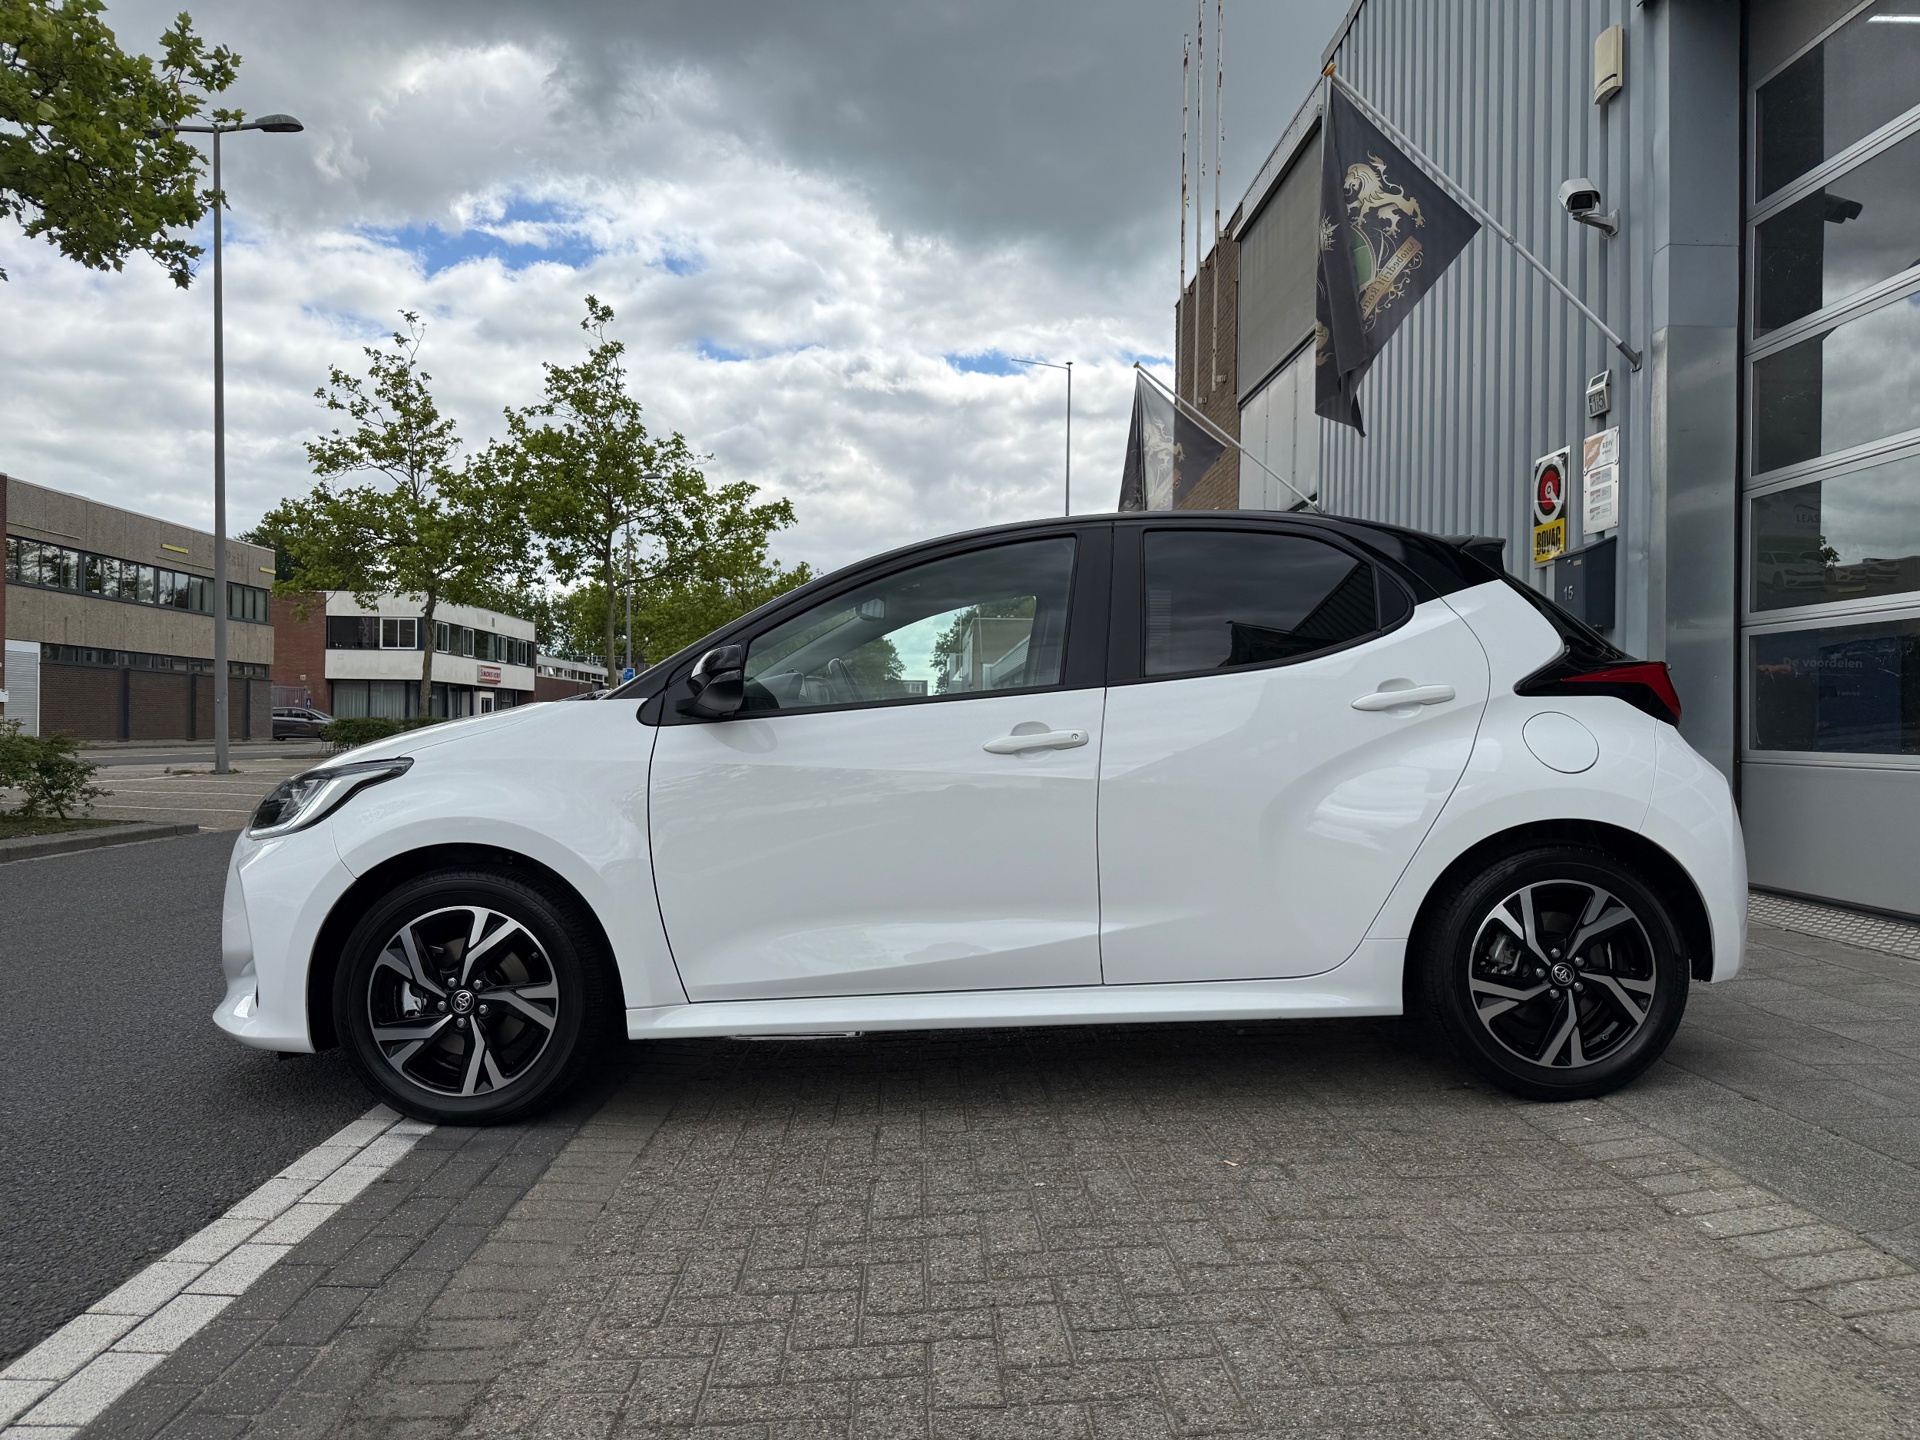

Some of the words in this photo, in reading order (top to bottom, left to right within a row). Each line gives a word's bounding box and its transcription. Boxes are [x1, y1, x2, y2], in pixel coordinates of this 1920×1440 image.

[1536, 526, 1561, 556] BOVAG
[1563, 585, 1574, 601] 15
[1802, 658, 1863, 669] voordelen
